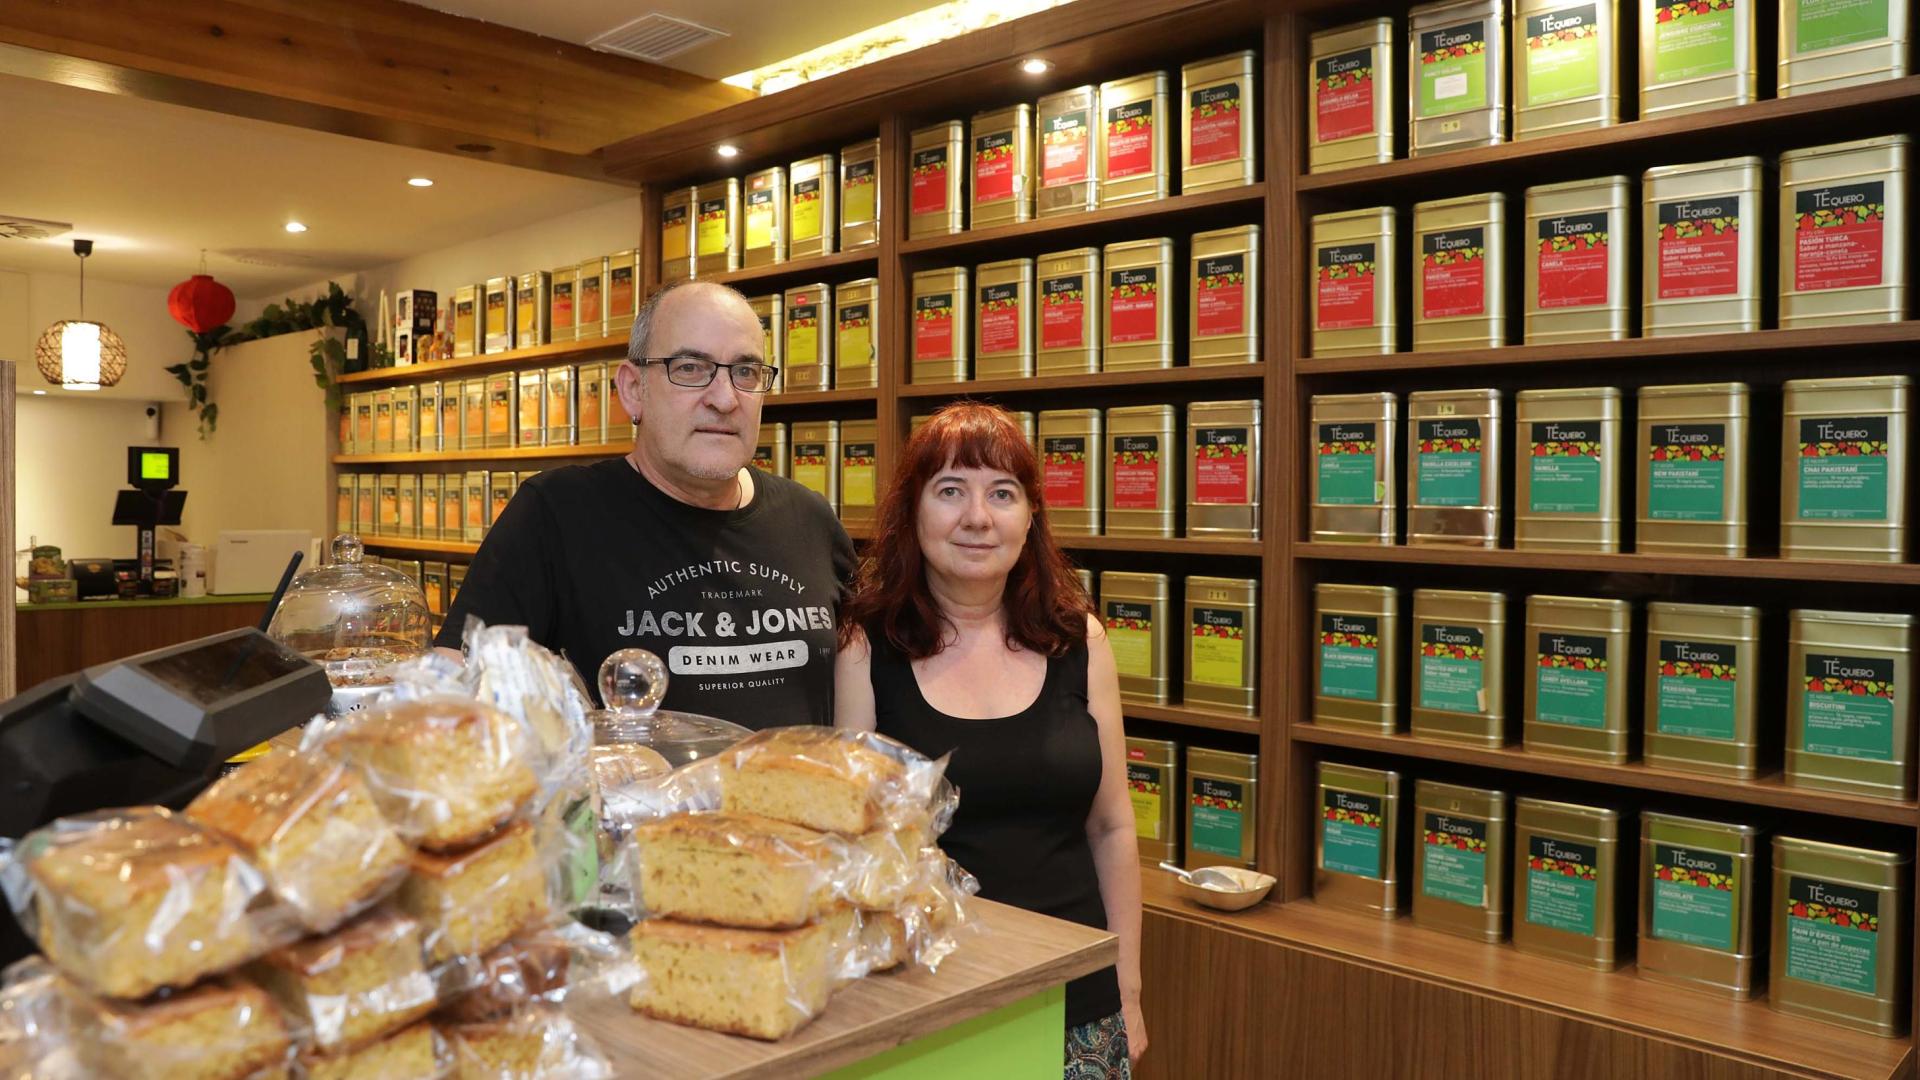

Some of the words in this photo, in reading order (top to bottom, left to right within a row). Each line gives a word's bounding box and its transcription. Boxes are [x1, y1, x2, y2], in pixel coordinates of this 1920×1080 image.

[1813, 189, 1830, 208] TÉ
[1830, 193, 1865, 207] QUIERO
[1675, 200, 1691, 219] TÉ
[1691, 207, 1722, 219] QUIERO
[1800, 237, 1824, 246] PASIÓN
[1665, 426, 1680, 443] TÉ
[1680, 433, 1709, 443] QUIERO
[1817, 421, 1834, 440] TÉ
[1834, 430, 1869, 441] QUIERO
[1821, 465, 1858, 473] PAKISTANÍ
[648, 561, 742, 599] AUTHENTIC
[750, 563, 805, 594] SUPPLY
[701, 589, 763, 599] TRADEMARK
[617, 610, 707, 637] JACK
[715, 612, 737, 637] &
[746, 606, 832, 635] JONES
[682, 655, 740, 666] DENIM
[750, 649, 796, 664] WEAR
[1675, 643, 1689, 660] TÉ
[1689, 652, 1719, 662] QUIERO
[1823, 658, 1840, 675] TÉ
[1840, 668, 1875, 678] QUIERO
[699, 682, 744, 691] SUPERIOR
[748, 677, 785, 688] QUALITY
[1672, 849, 1686, 866] TÉ
[1686, 858, 1717, 870] QUIERO
[1808, 884, 1824, 902] TÉ
[1824, 895, 1859, 908] QUIERO
